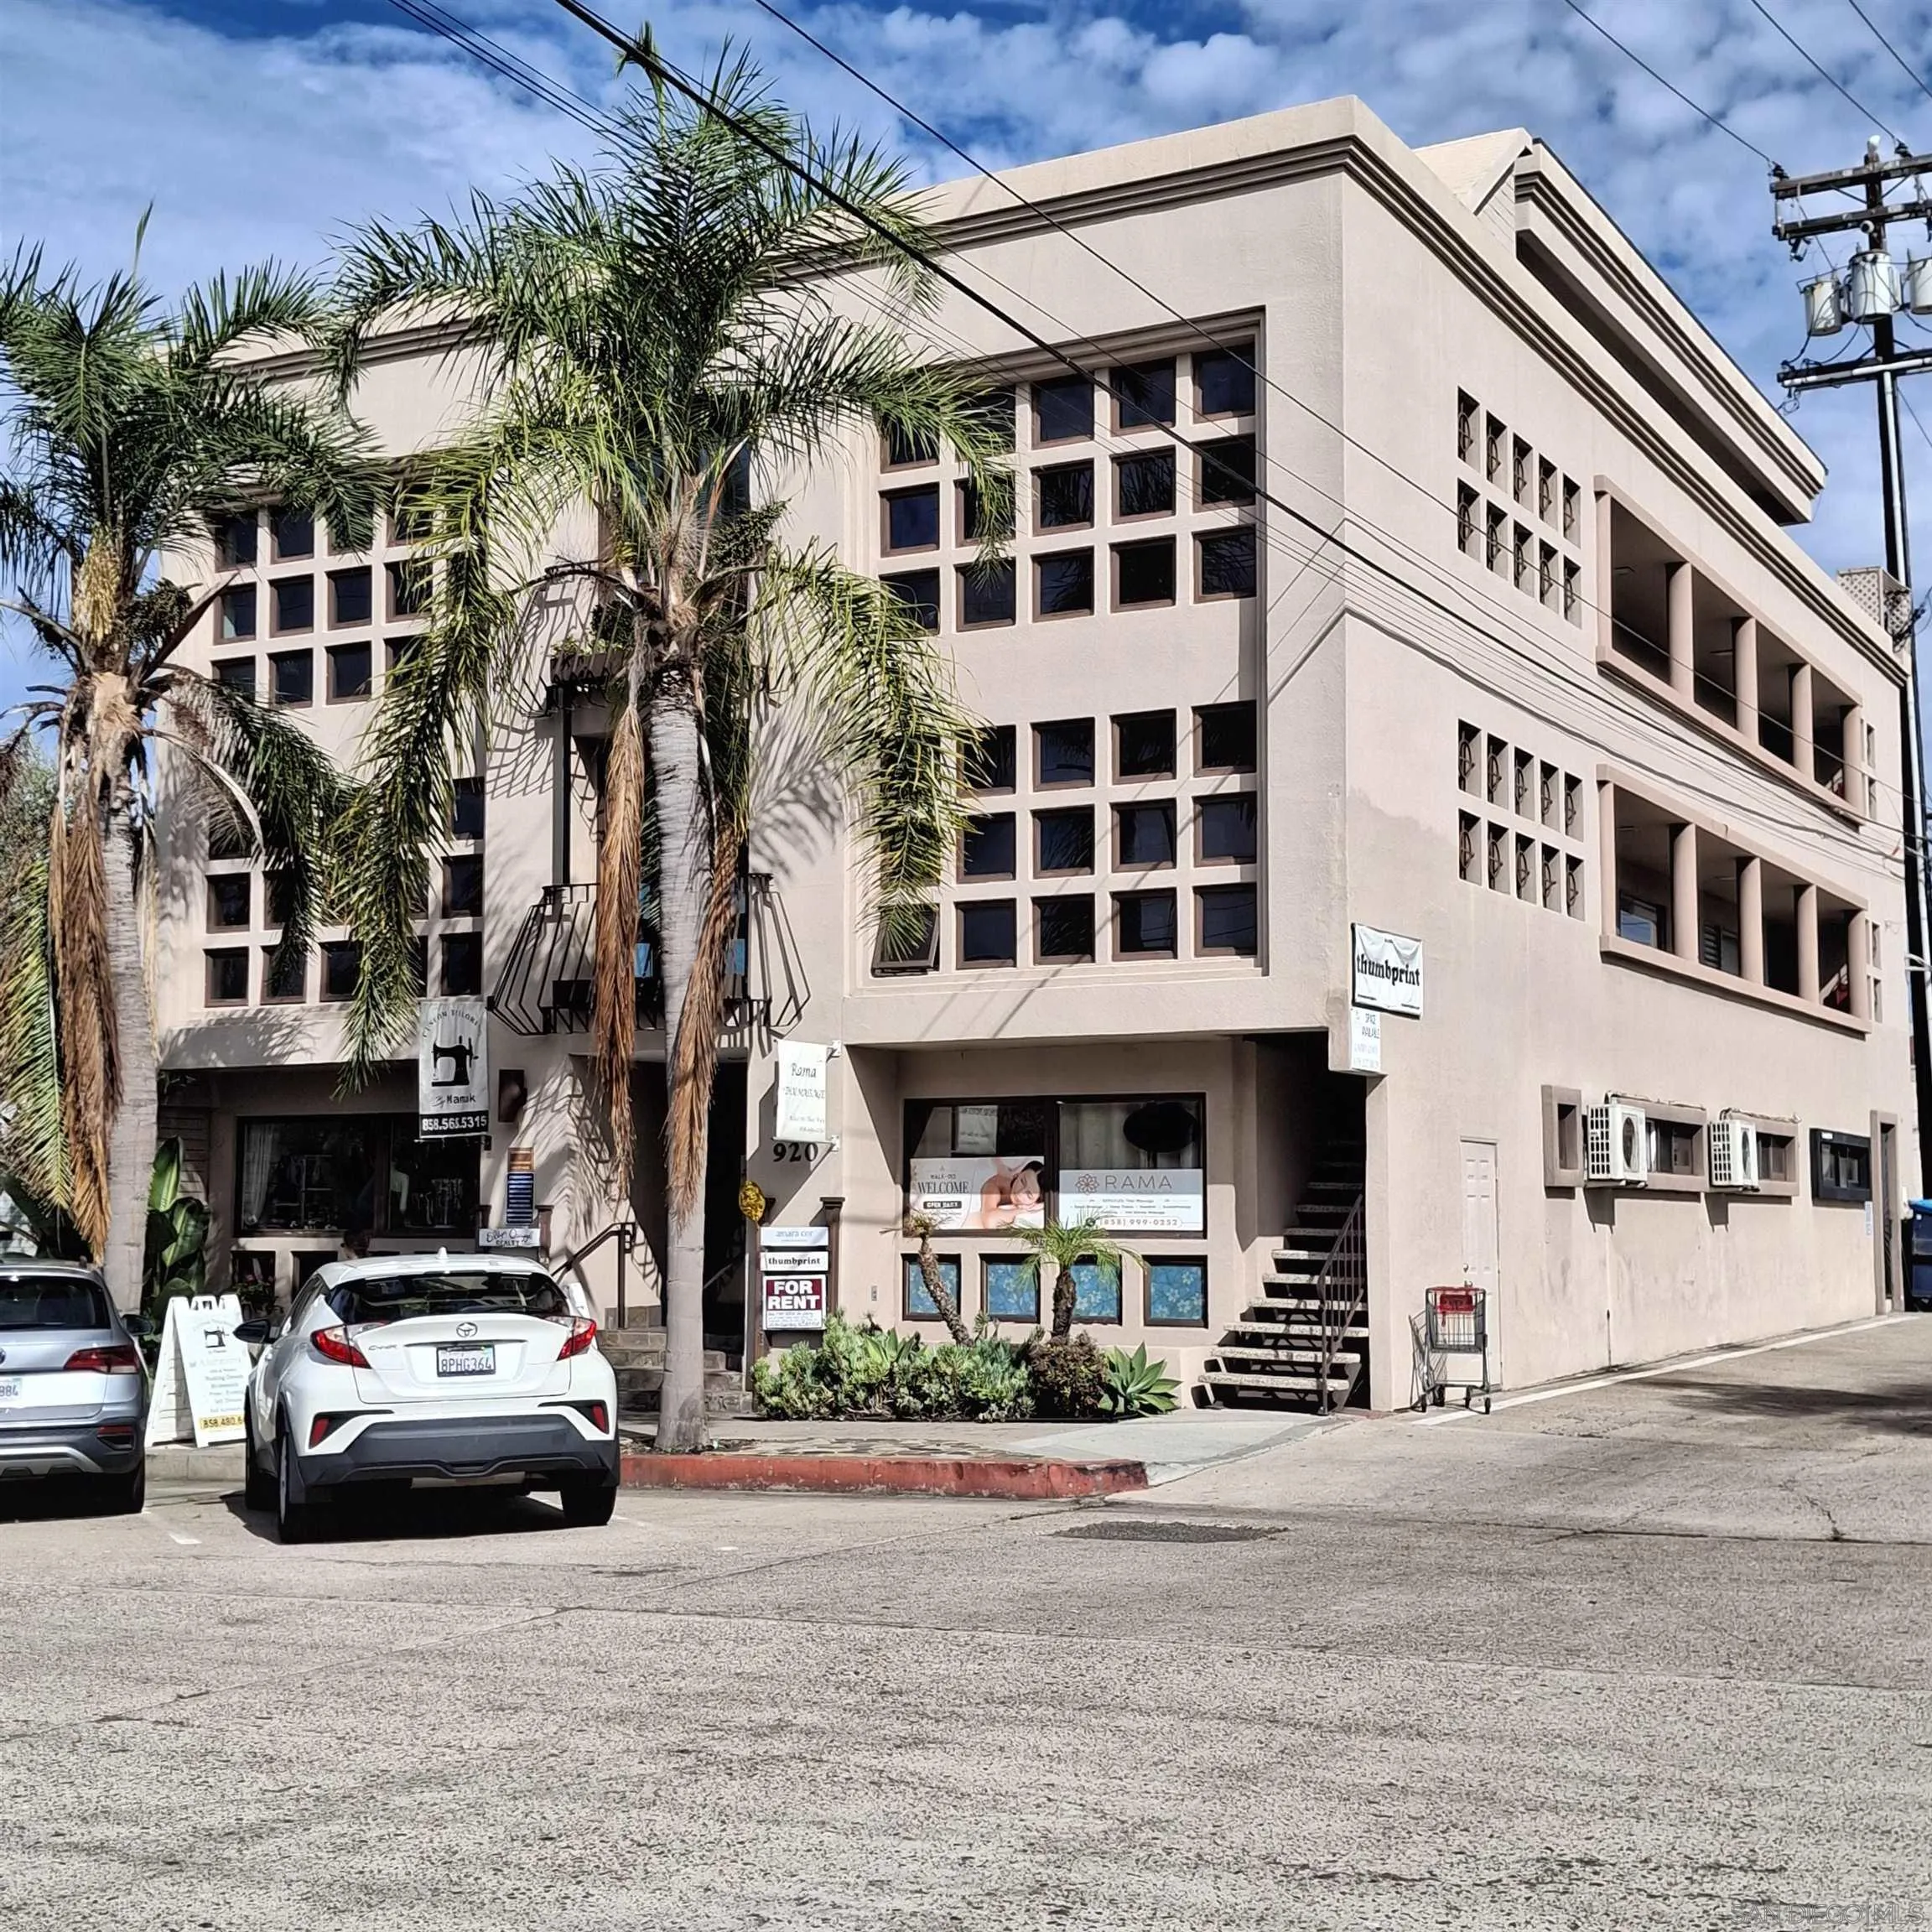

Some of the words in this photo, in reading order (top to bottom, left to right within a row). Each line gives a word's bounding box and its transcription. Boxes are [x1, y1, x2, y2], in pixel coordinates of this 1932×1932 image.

[1356, 953, 1420, 987] thumbprint
[791, 1062, 817, 1078] Rama
[772, 1141, 818, 1162] 920
[917, 1181, 970, 1195] WELCOME
[1104, 1175, 1173, 1190] RAMA
[768, 1257, 820, 1266] thumbprint
[774, 1280, 813, 1295] FOR
[768, 1296, 820, 1310] RENT
[441, 1358, 491, 1372] 8PHG364
